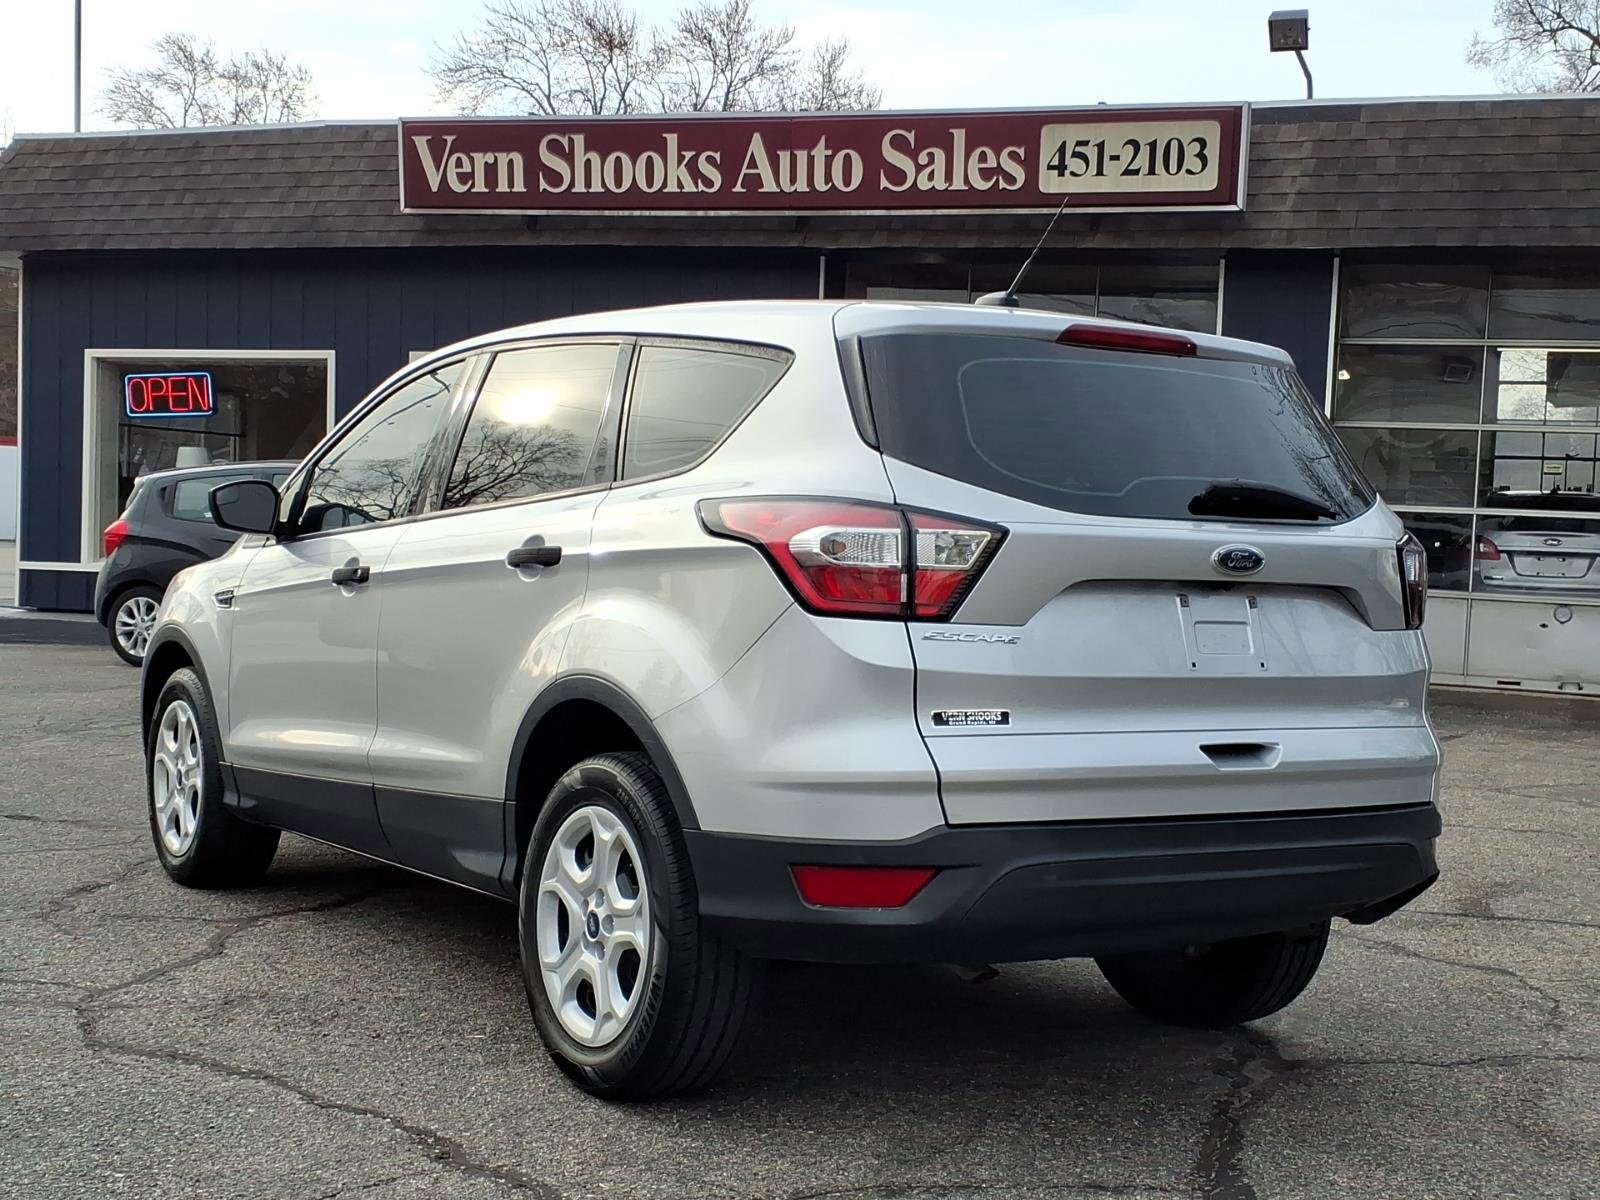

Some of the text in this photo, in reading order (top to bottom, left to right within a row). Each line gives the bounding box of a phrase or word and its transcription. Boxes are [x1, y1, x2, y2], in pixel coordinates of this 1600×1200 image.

[411, 128, 1209, 194] Vern Shooks Auto Sales 451-2103
[128, 376, 209, 412] OPEN
[1227, 551, 1256, 568] Ford
[921, 631, 1021, 645] ESCAPE
[941, 711, 1002, 721] VERN SHOOKS
